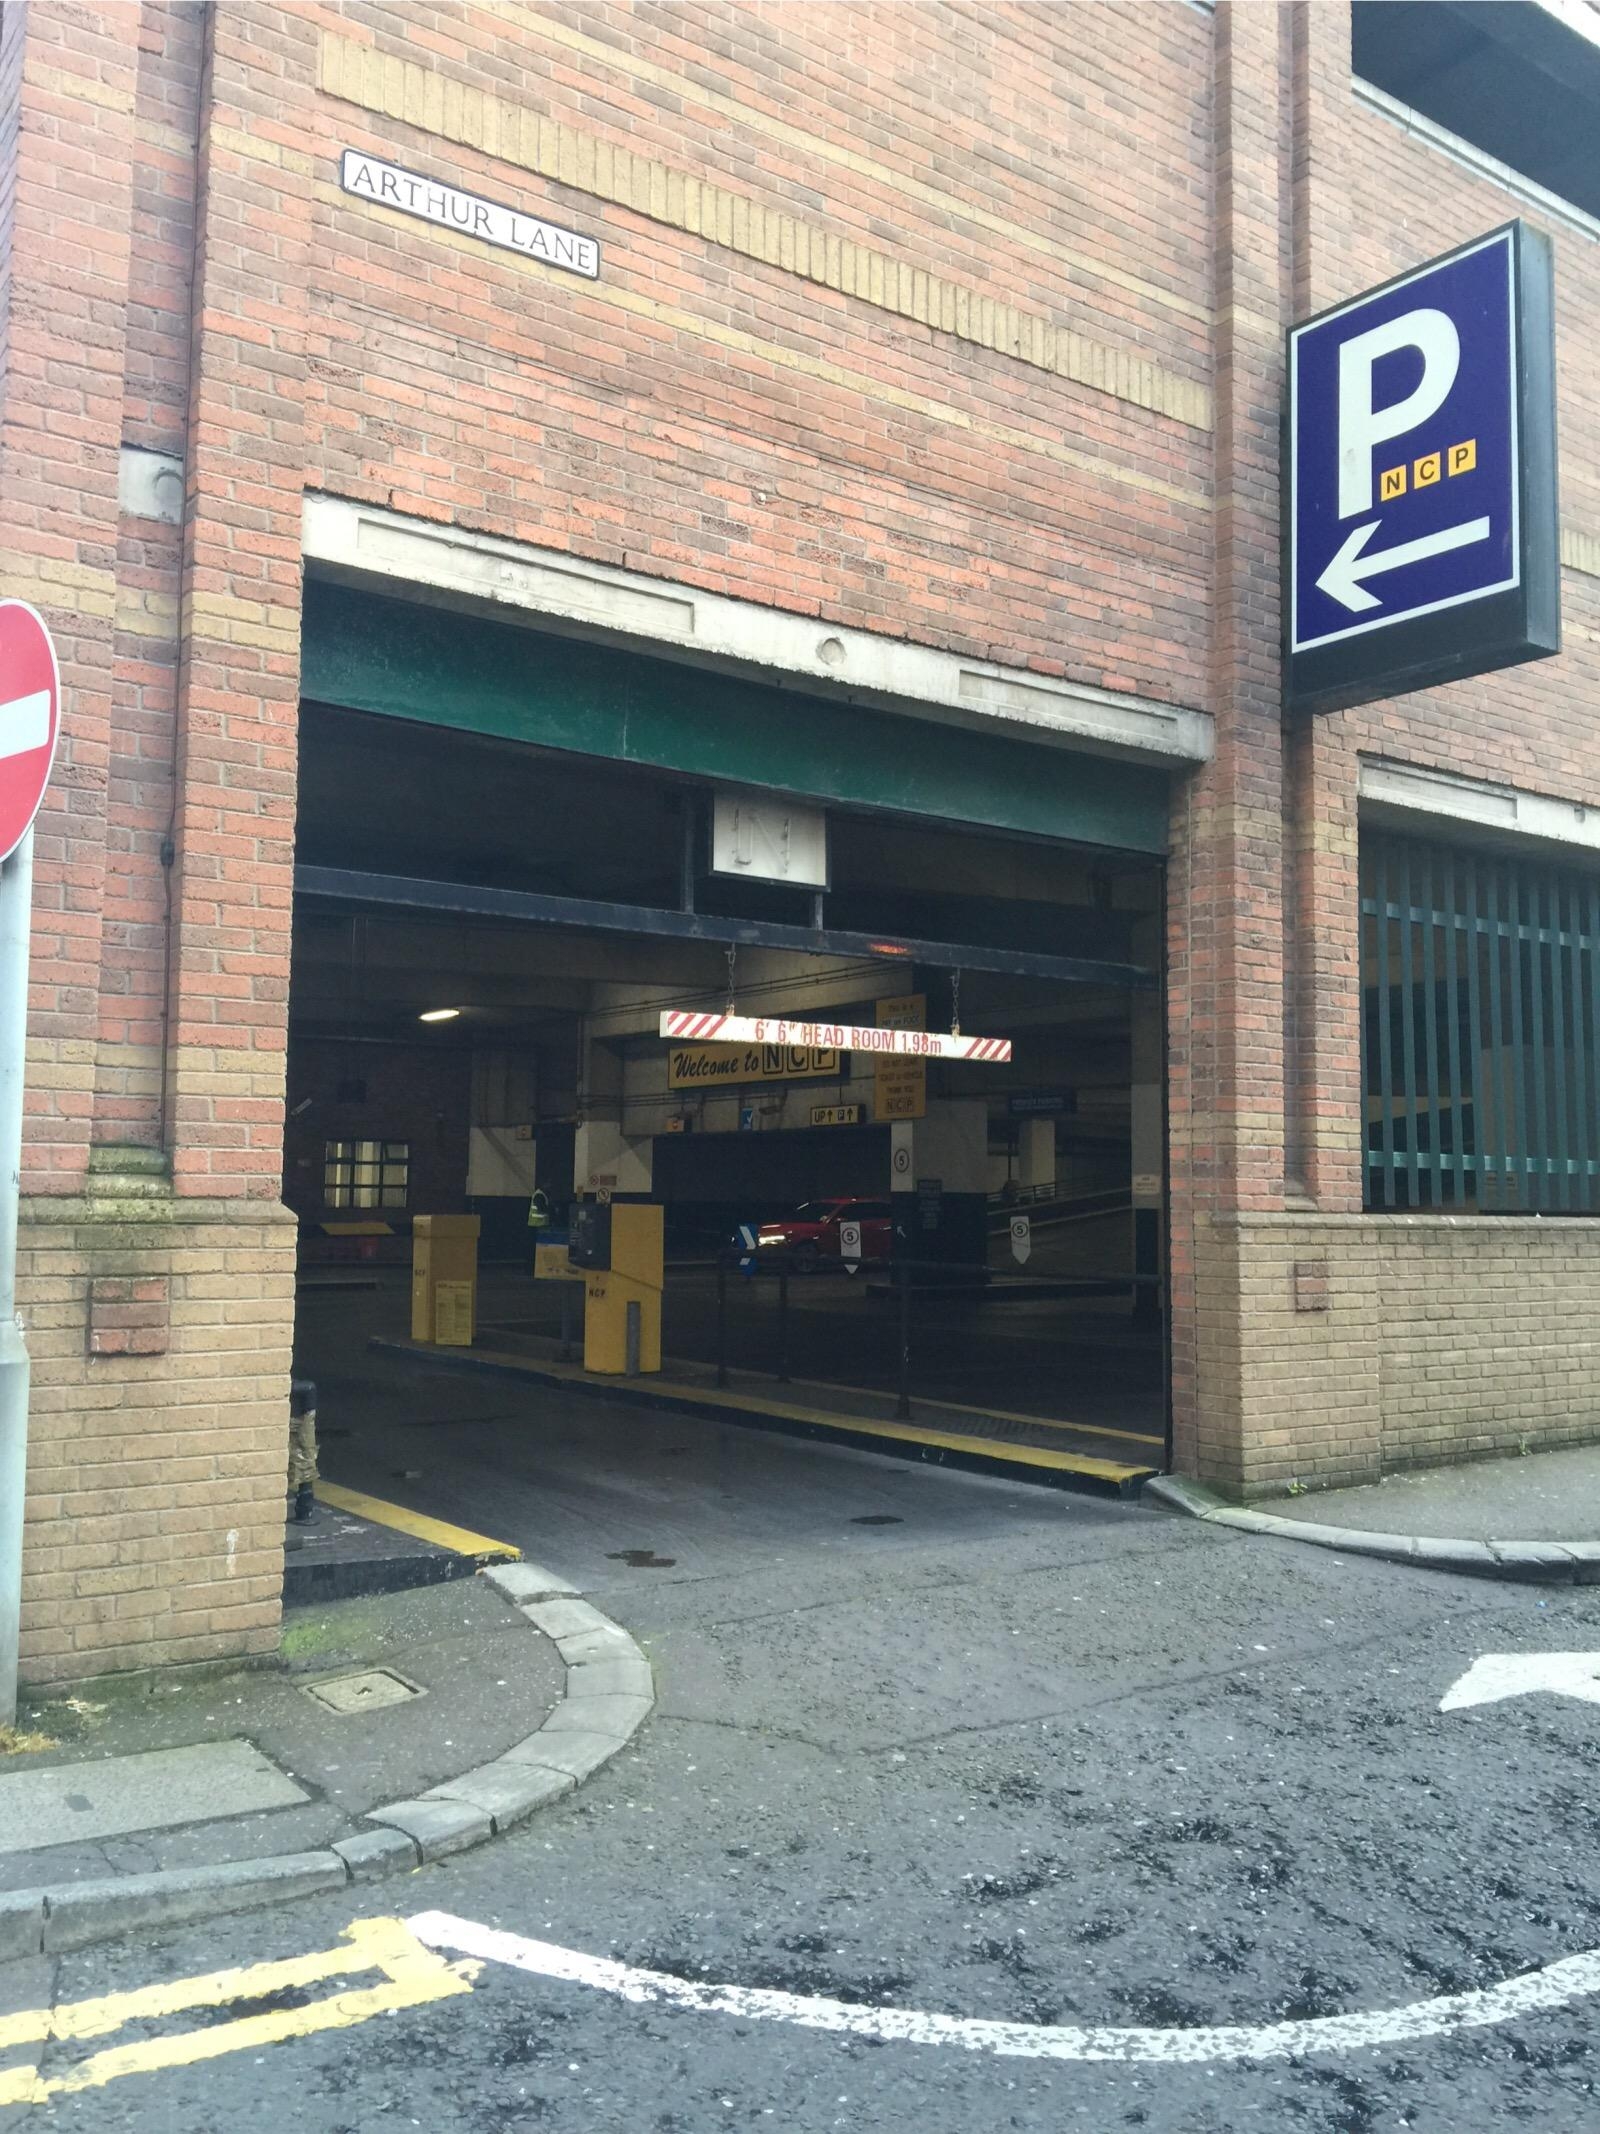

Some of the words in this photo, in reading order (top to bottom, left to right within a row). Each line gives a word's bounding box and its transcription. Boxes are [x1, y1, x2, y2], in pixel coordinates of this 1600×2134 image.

[353, 164, 493, 235] ARTHUR
[511, 217, 591, 270] LANE
[1338, 308, 1460, 520] P
[801, 1022, 844, 1047] HEAD
[852, 1027, 895, 1051] ROOM
[901, 1032, 942, 1054] 1.98m
[674, 1052, 738, 1078] Welcome
[744, 1050, 759, 1072] to
[815, 1110, 826, 1122] UP
